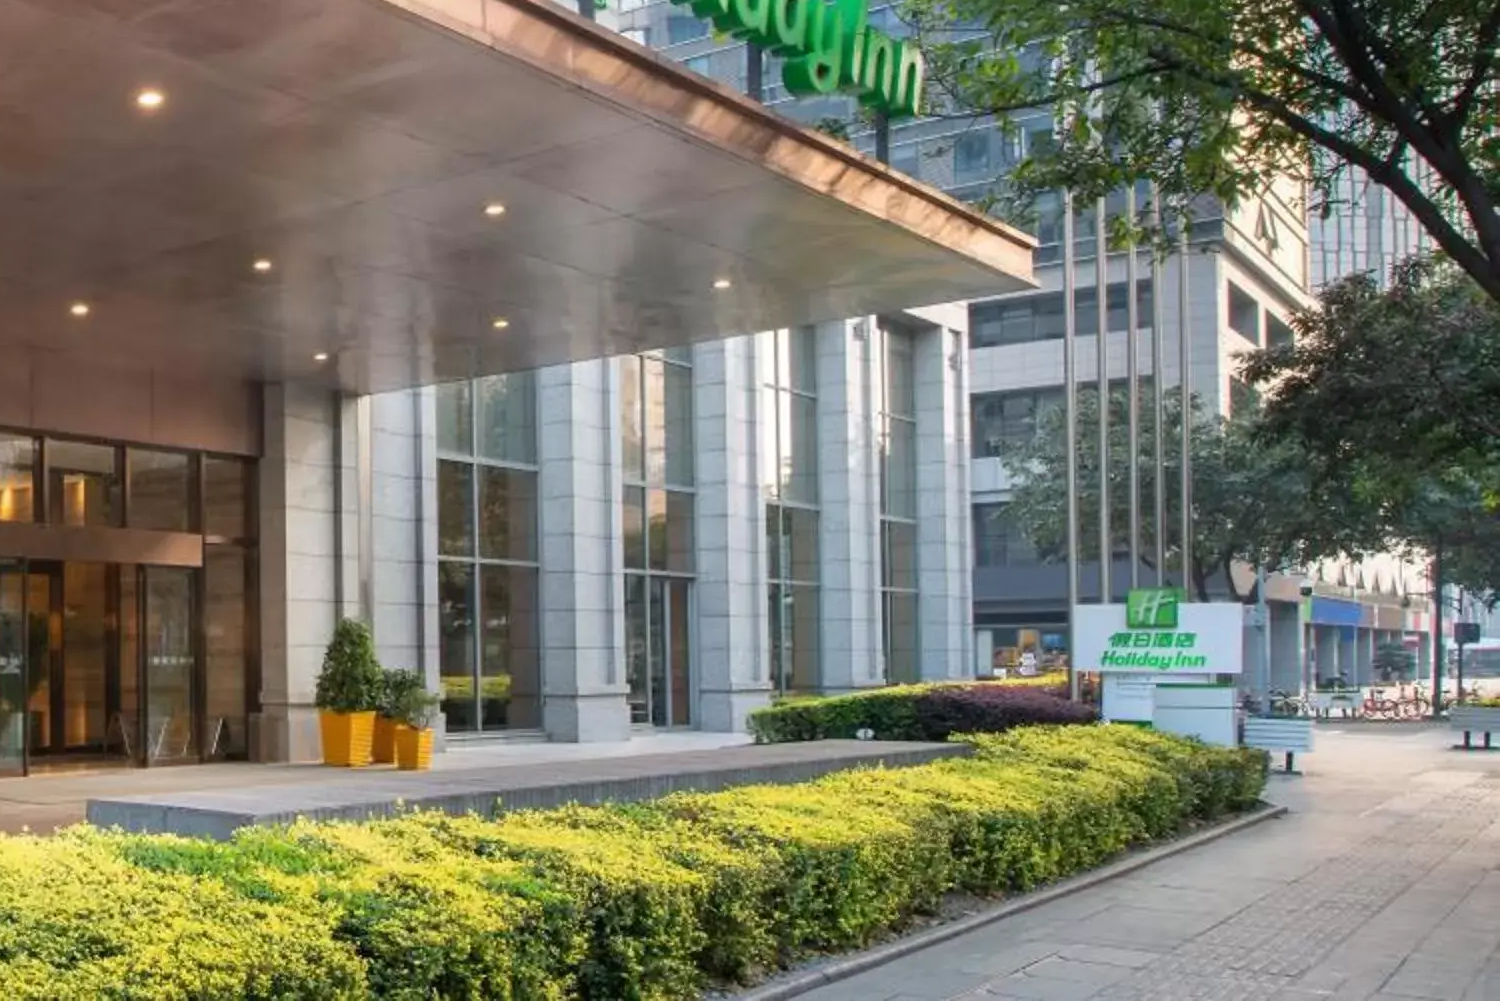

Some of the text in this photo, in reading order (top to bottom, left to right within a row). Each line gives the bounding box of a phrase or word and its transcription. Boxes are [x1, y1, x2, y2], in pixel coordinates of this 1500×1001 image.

[1108, 632, 1197, 648] 假日酒店
[1101, 651, 1206, 670] Holiday Inn
